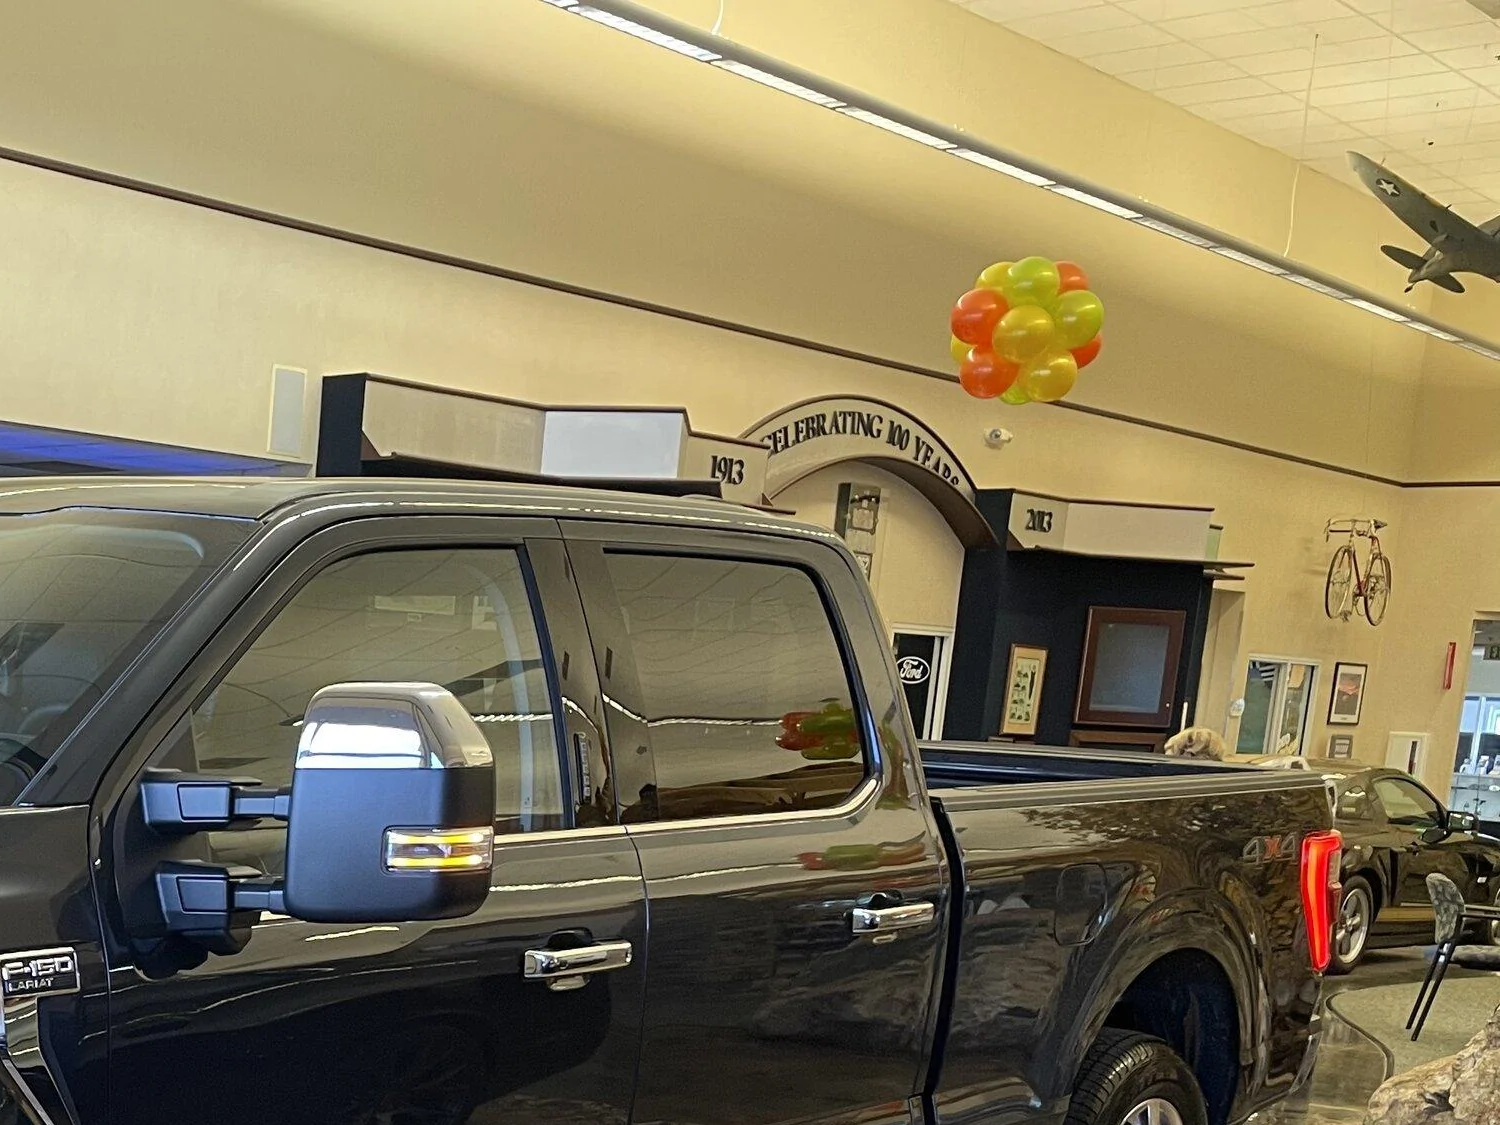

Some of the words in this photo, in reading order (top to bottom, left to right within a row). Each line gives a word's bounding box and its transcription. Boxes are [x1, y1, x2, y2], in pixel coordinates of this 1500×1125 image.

[760, 411, 883, 459] CELEBRATING
[886, 420, 910, 451] 100
[912, 436, 959, 486] YEARS
[710, 455, 745, 485] 1913
[1025, 508, 1053, 533] 2013
[899, 659, 925, 680] Ford
[1, 955, 74, 981] F-150
[8, 977, 54, 992] LARIAT
